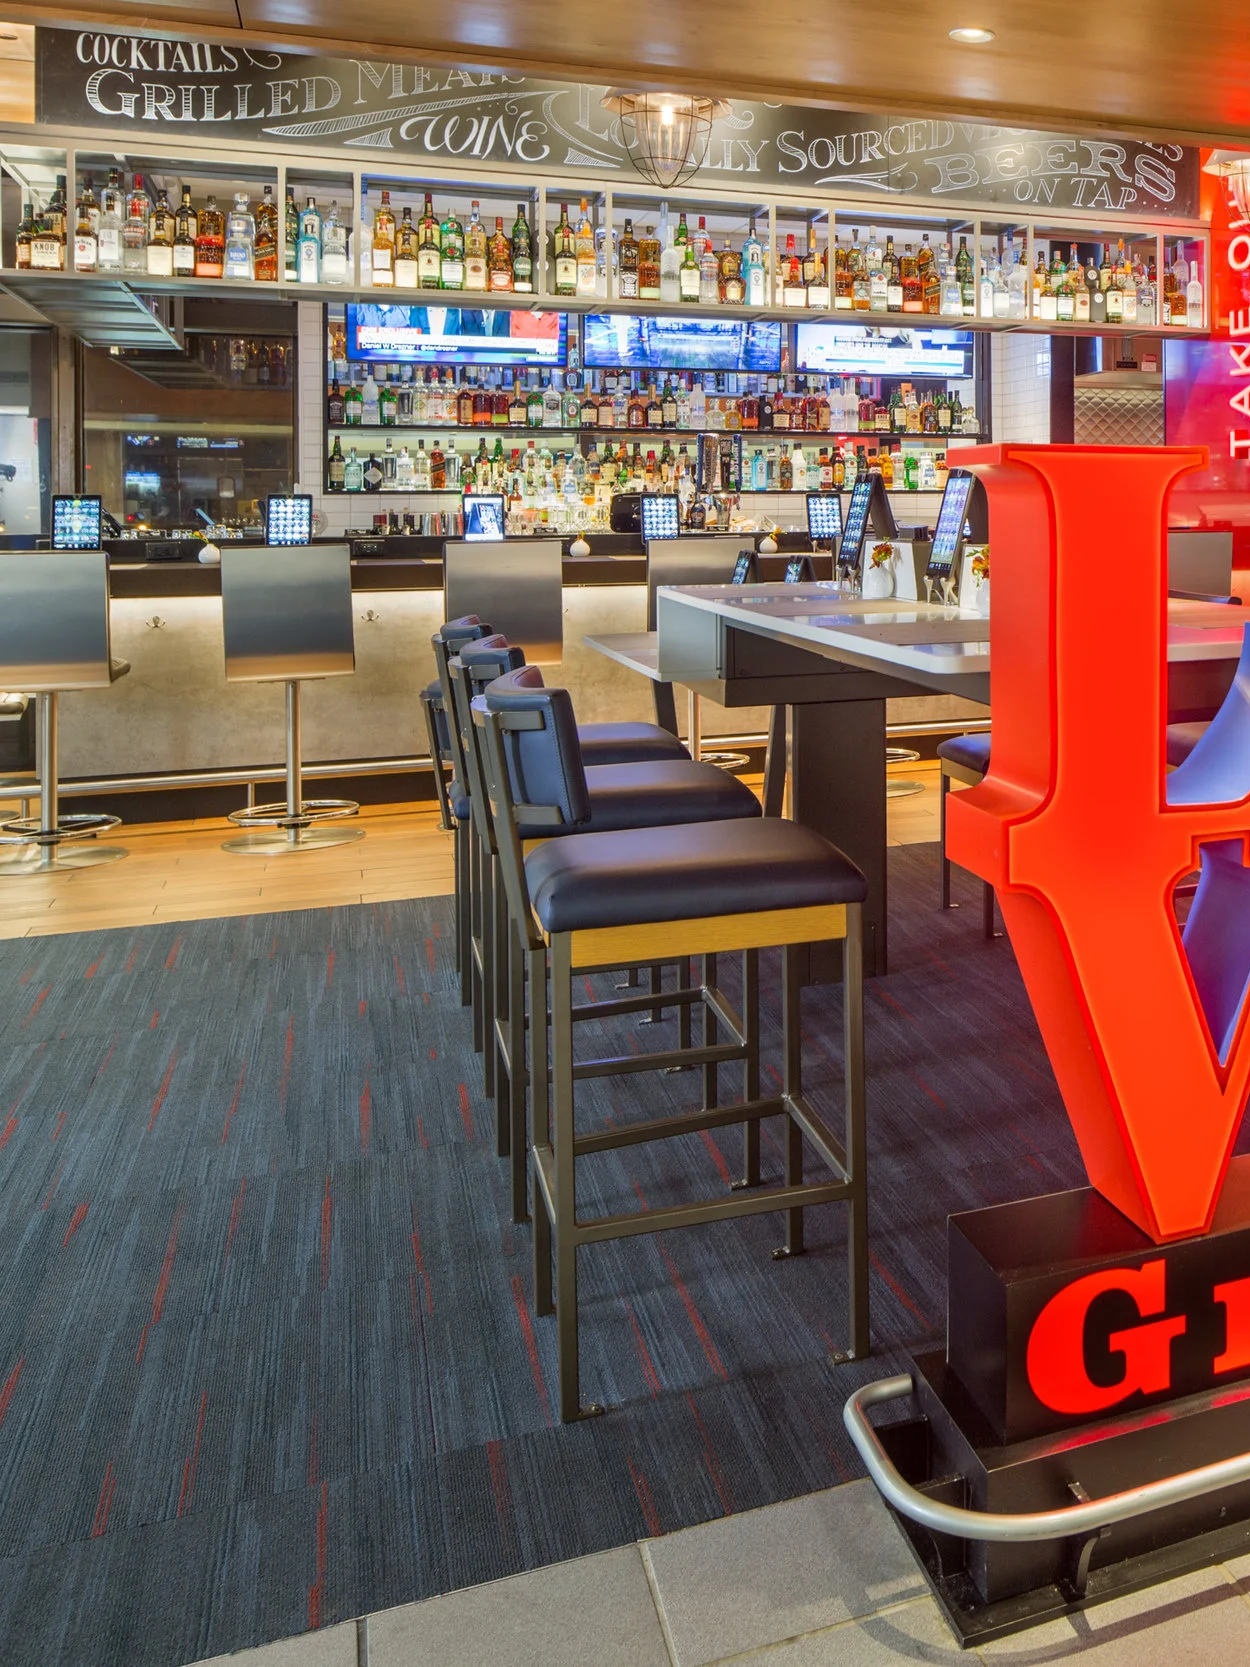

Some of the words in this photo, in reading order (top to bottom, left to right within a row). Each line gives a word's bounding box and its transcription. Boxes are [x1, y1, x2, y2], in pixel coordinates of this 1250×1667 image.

[76, 33, 239, 72] COCKTAILS
[86, 68, 341, 121] GRILLED
[400, 110, 549, 162] WINE
[776, 119, 955, 173] SOURCED
[924, 139, 1176, 202] BEERS
[1014, 178, 1061, 204] ON
[1070, 177, 1137, 210] TAP
[33, 243, 55, 251] KNOB
